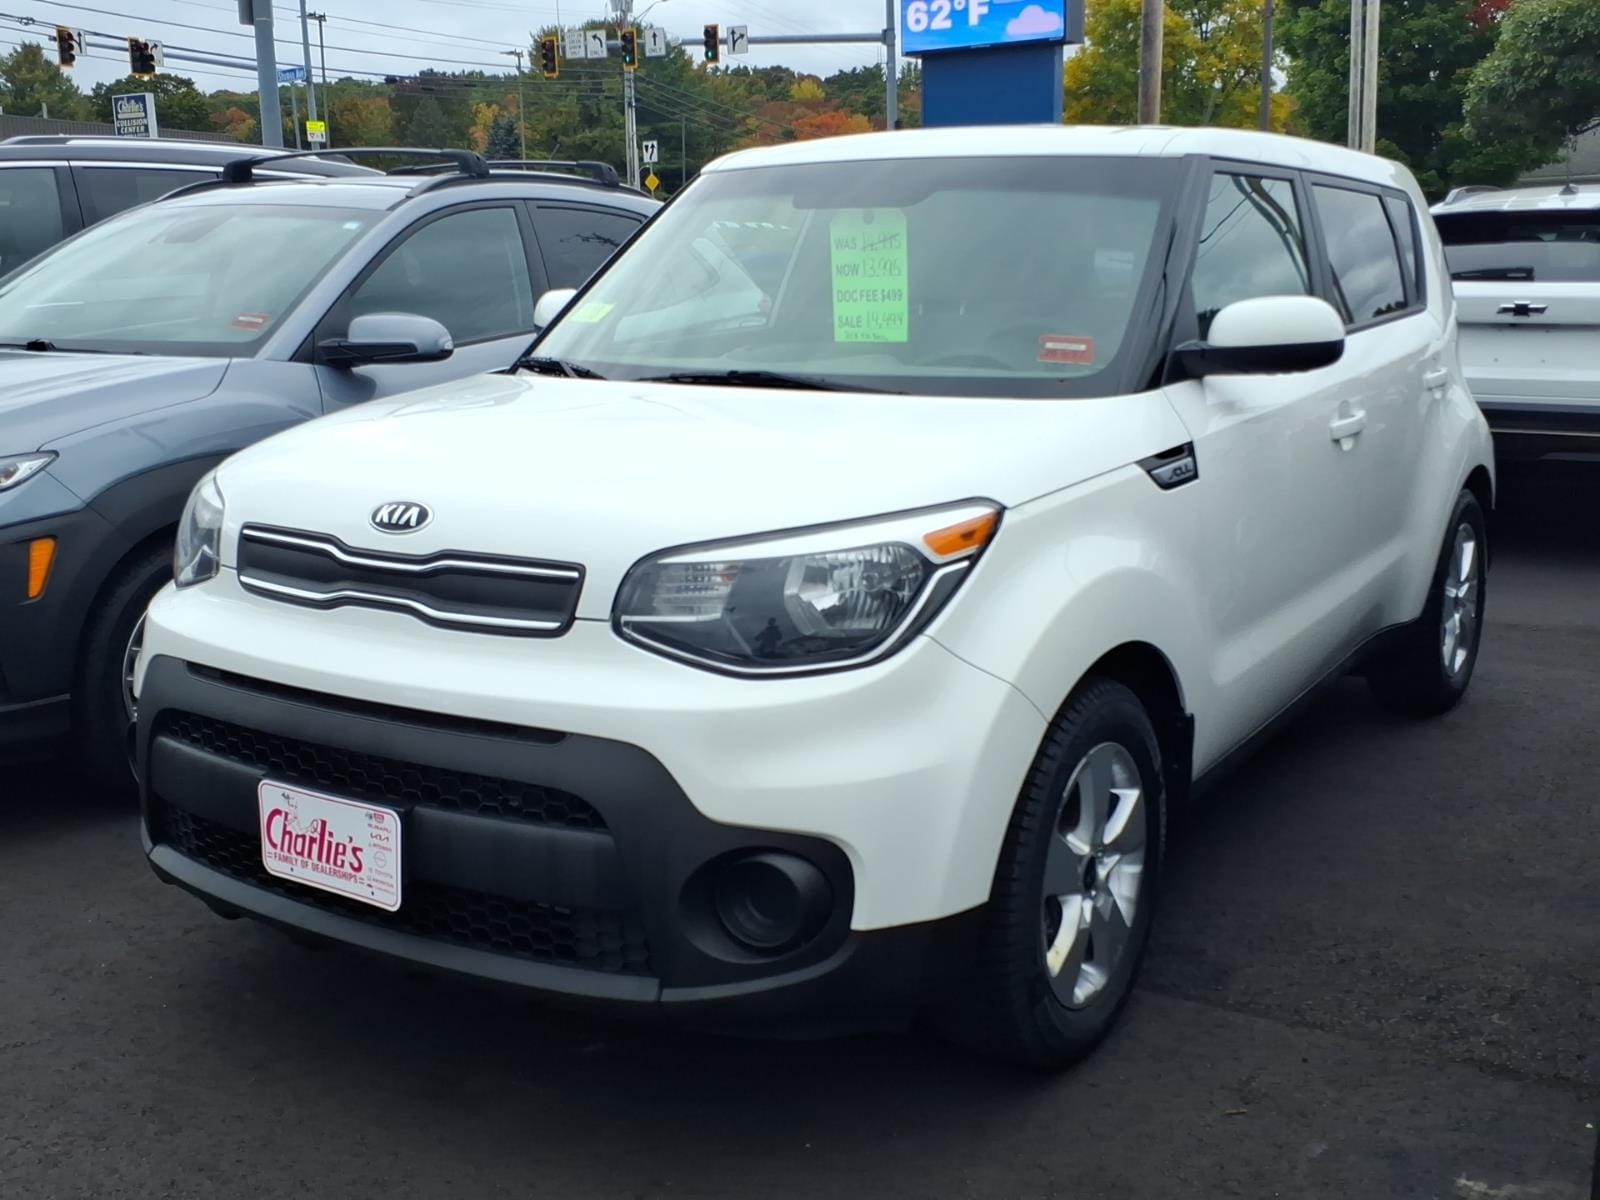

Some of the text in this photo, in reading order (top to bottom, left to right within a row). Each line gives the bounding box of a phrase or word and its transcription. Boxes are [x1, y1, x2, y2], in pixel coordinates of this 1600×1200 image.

[906, 0, 990, 32] 62°F
[116, 118, 148, 127] COLLISION
[120, 126, 145, 134] CENTER
[835, 238, 858, 250] WAS
[836, 263, 860, 277] NOW
[837, 288, 904, 303] DOC FEE $499
[838, 315, 863, 329] SALE
[375, 504, 420, 527] KIA
[265, 807, 364, 873] Charlie's
[273, 851, 298, 866] FAMILY
[300, 858, 310, 869] OF
[311, 860, 359, 885] DEALERSHIPS
